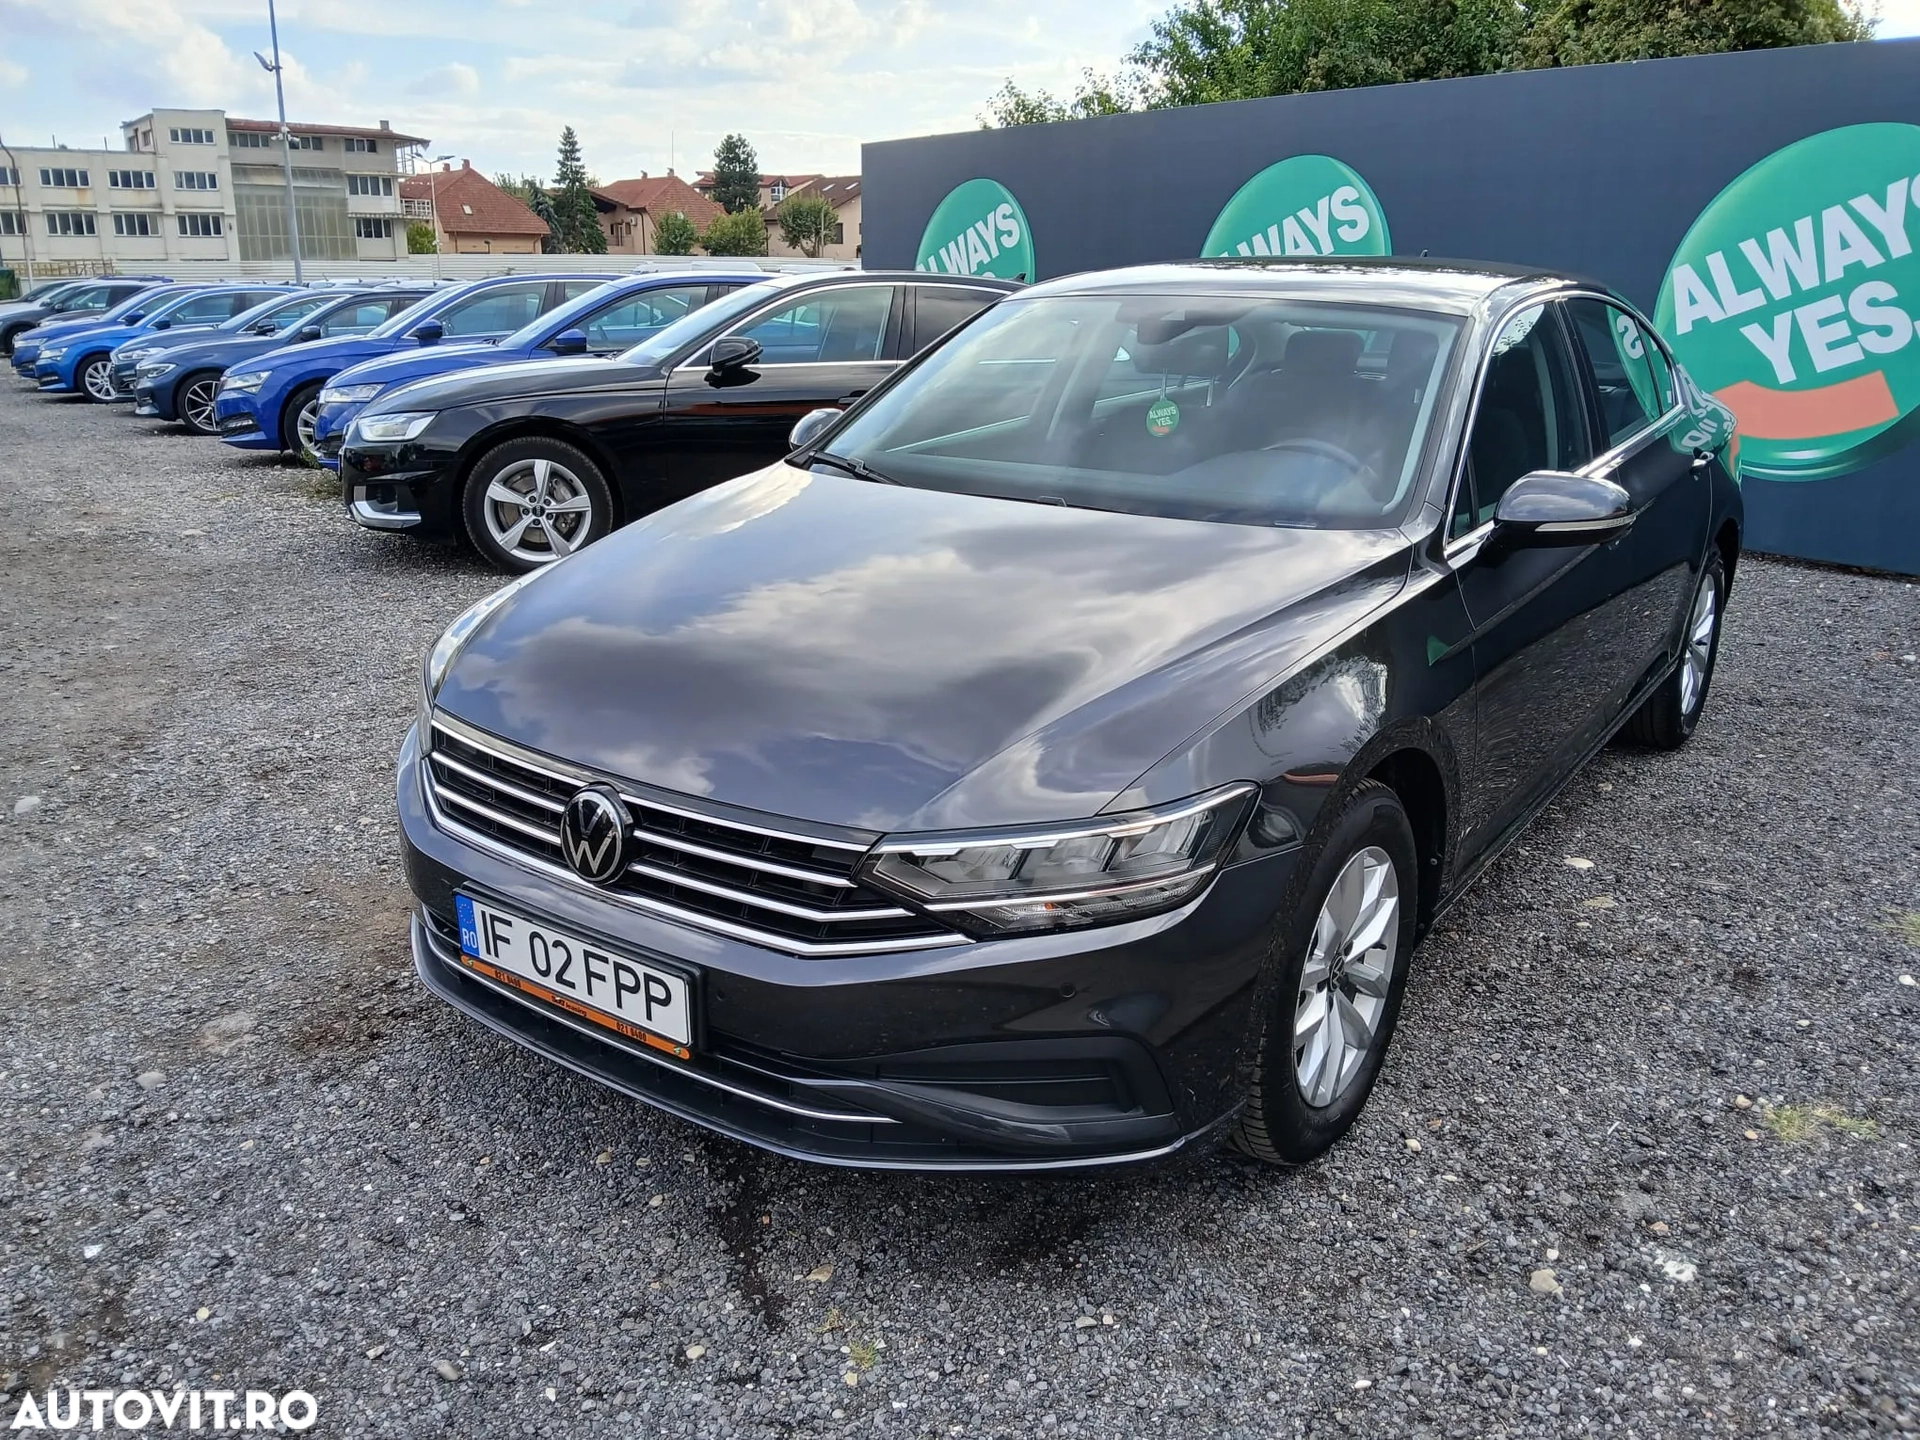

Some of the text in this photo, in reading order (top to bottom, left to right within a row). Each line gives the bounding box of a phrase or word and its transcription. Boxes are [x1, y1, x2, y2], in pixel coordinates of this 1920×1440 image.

[1672, 174, 1920, 335] ALWAY
[1149, 406, 1177, 419] ALWAYS
[463, 928, 478, 948] RO
[481, 909, 512, 958] IF
